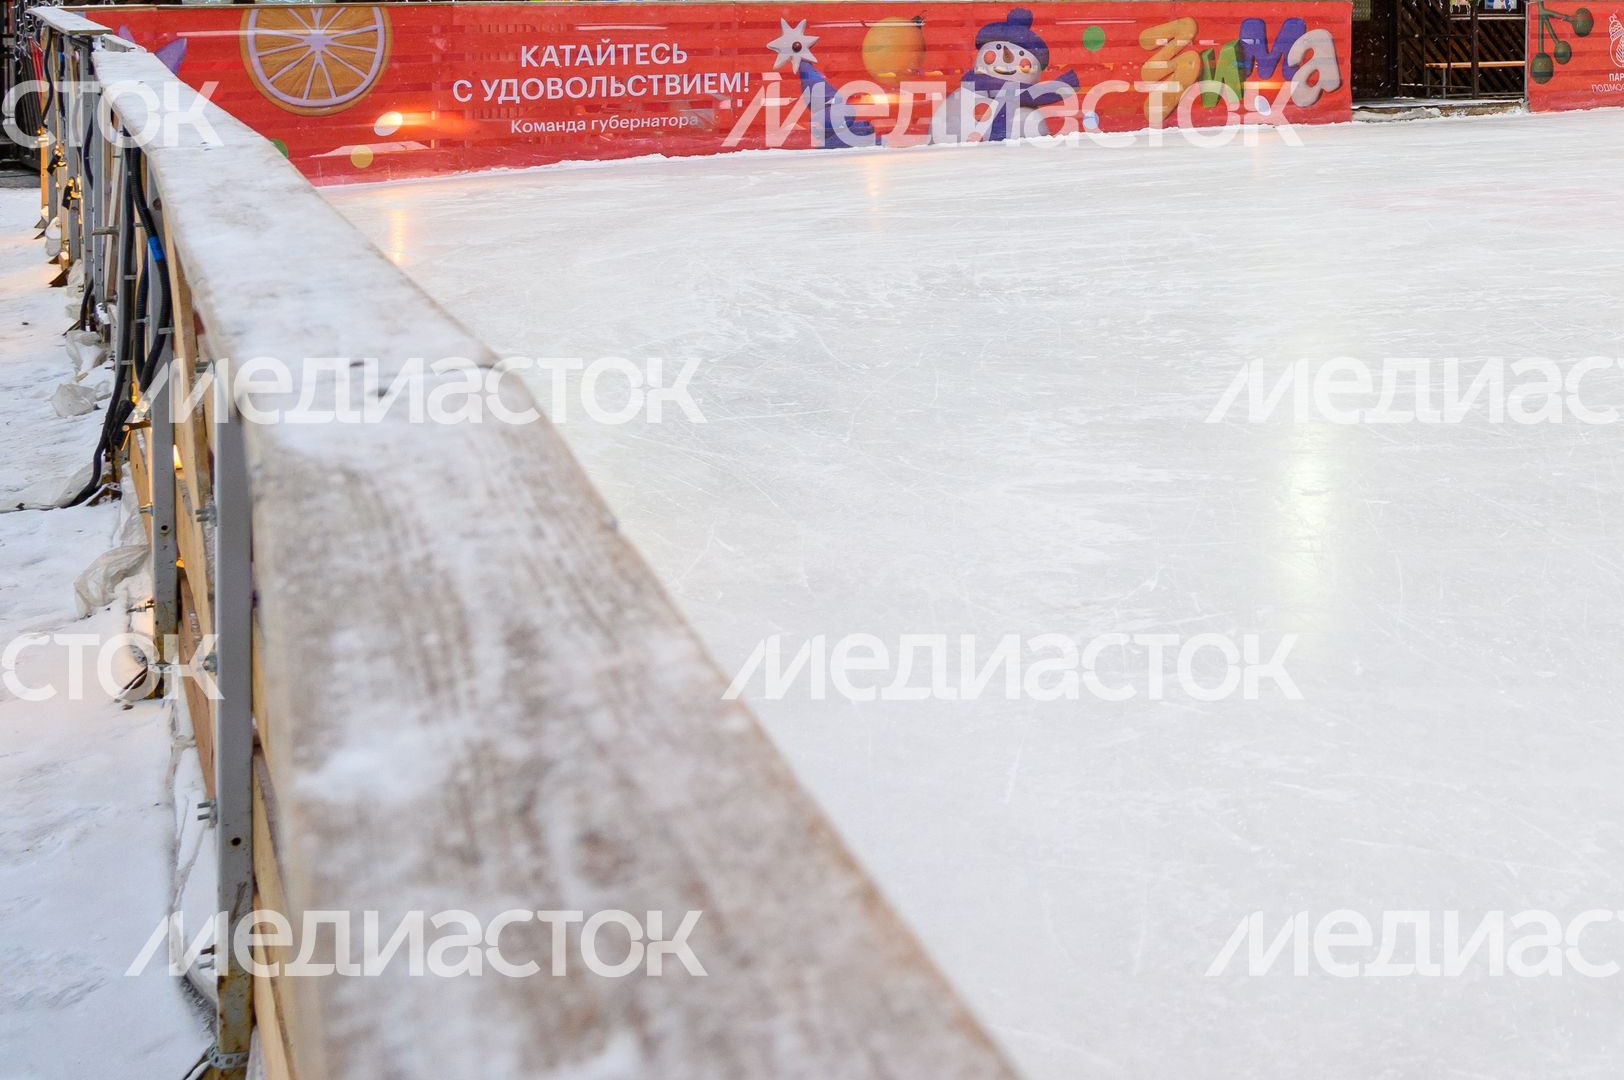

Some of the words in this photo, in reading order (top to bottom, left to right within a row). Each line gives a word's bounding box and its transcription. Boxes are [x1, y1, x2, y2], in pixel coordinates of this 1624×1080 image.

[521, 38, 689, 68] КАТАЙТЕСЬ
[452, 80, 473, 102] С
[480, 72, 750, 105] УДОВОЛЬСТВИЕМ!
[511, 119, 586, 134] Команда
[591, 114, 699, 133] губернатора
